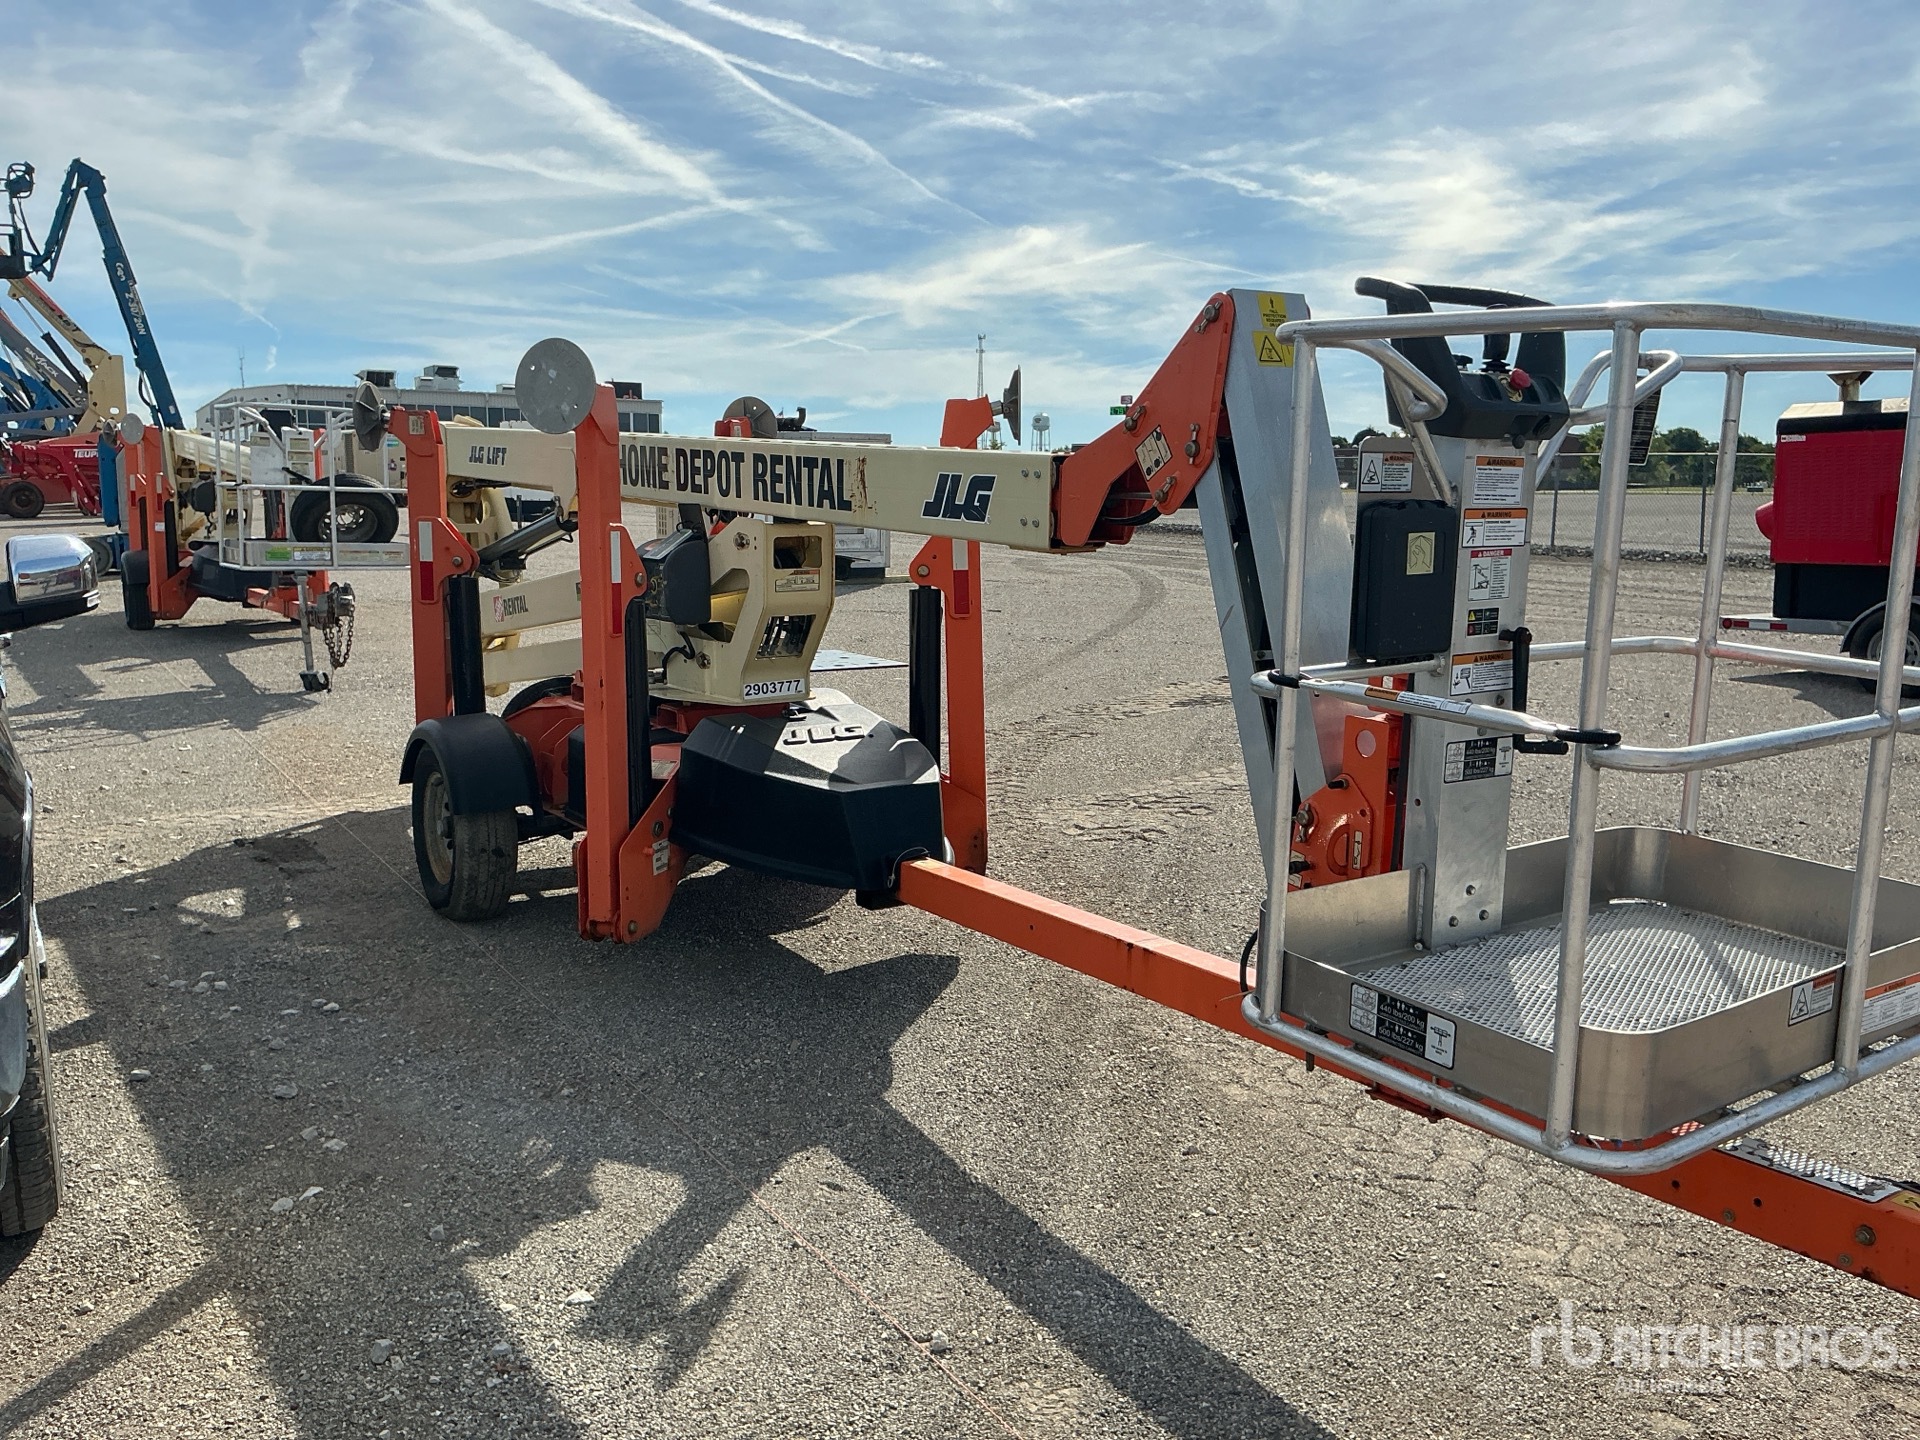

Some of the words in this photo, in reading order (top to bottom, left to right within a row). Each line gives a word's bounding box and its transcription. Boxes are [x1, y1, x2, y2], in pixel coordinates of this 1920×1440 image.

[469, 446, 485, 464] JLG
[487, 447, 507, 466] LIFT
[620, 444, 669, 490] HOME
[675, 447, 745, 498] DEPOT
[753, 452, 852, 511] RENTAL
[921, 472, 997, 524] JLG
[503, 595, 528, 617] RENTAL
[1479, 653, 1505, 662] WARNING
[744, 680, 801, 697] 2903777
[783, 725, 866, 745] JLG
[1380, 1004, 1392, 1013] 440
[1392, 1009, 1416, 1023] lbs/200
[1416, 1018, 1425, 1029] kg
[1378, 1026, 1391, 1037] 500
[1415, 1041, 1423, 1052] kg
